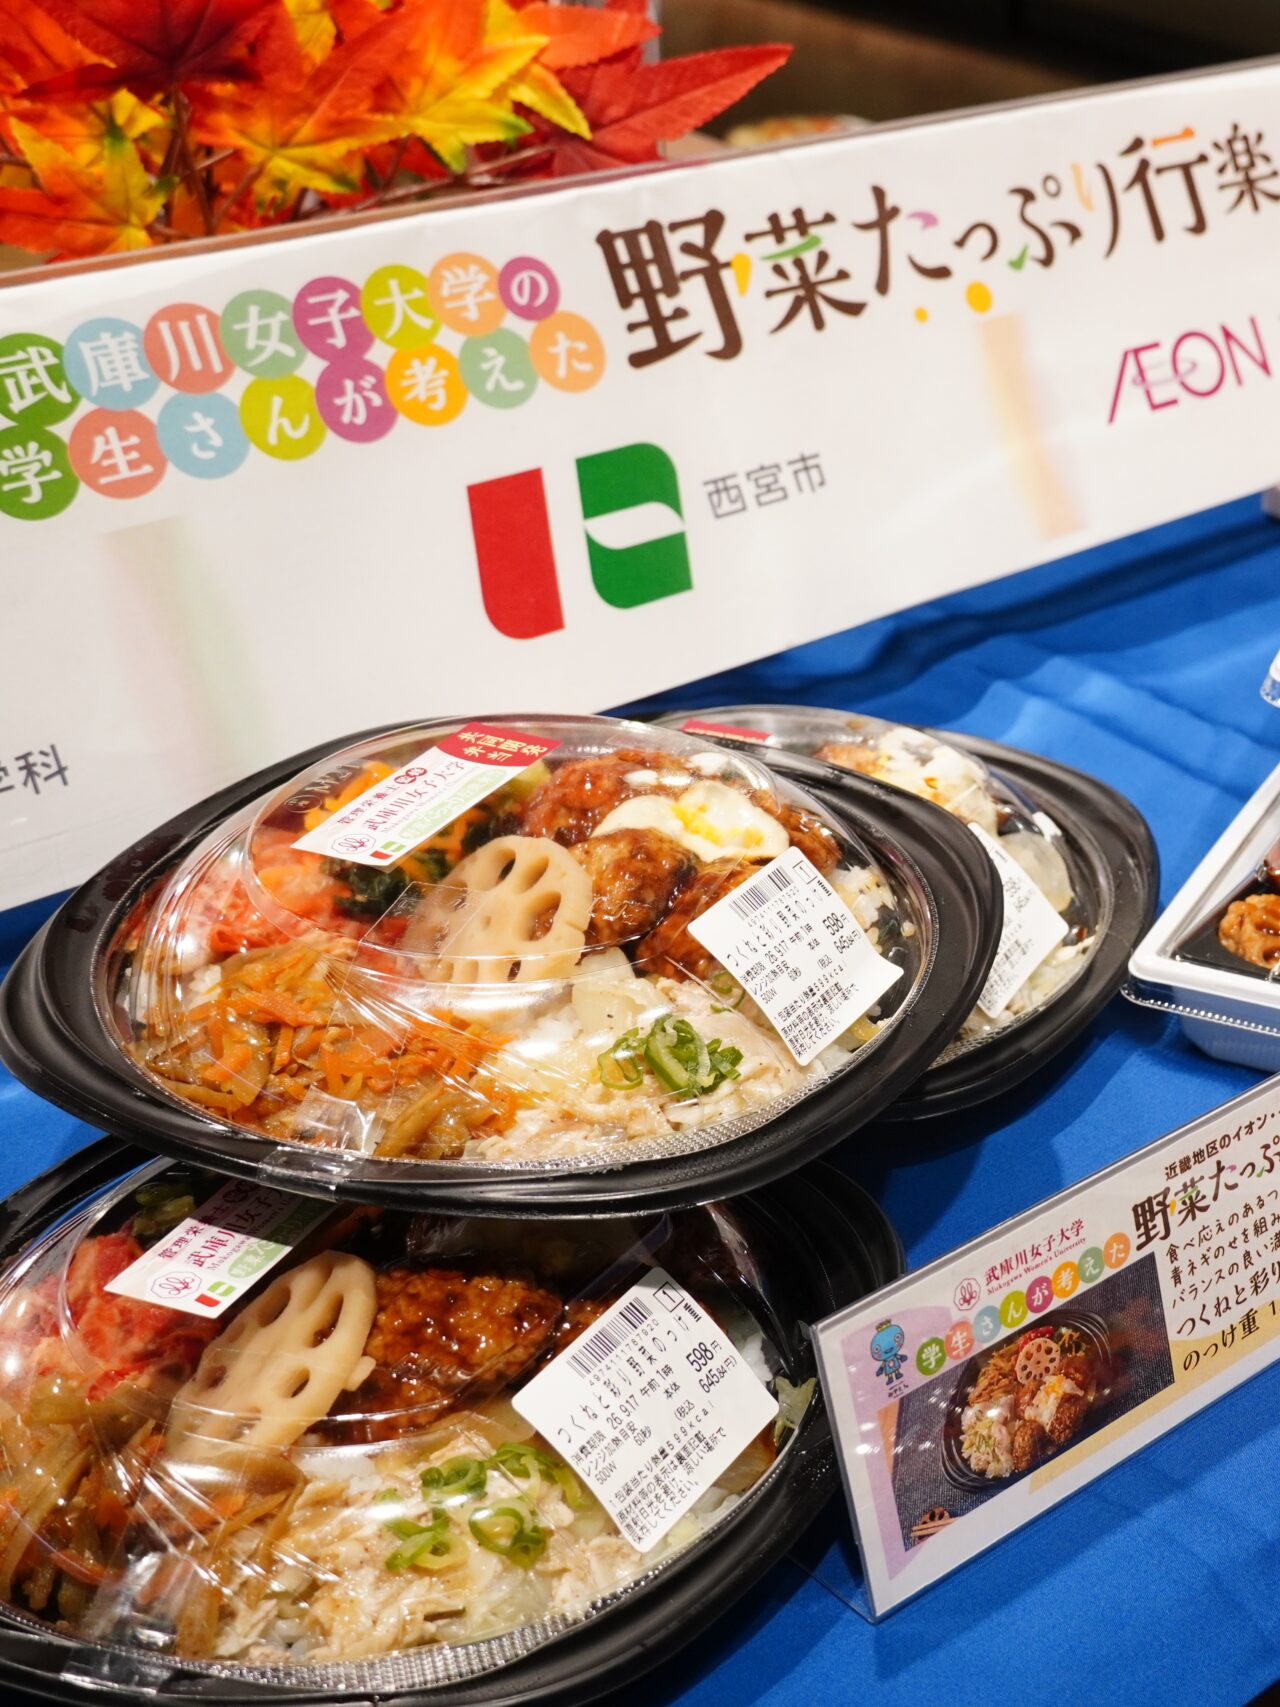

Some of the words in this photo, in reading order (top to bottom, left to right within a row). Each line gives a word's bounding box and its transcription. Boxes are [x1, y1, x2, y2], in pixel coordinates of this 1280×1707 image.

[0, 266, 548, 415] 武庫川女子大学の
[0, 331, 594, 504] 学生さんが考えた
[703, 452, 827, 521] 西宮市
[458, 732, 548, 756] 共同開発
[463, 746, 512, 762] 弁当
[363, 761, 464, 831] 武庫川女子大学
[986, 1218, 1084, 1286] 武庫川女子大学
[1023, 1256, 1052, 1274] Women's
[1054, 1237, 1086, 1258] University
[921, 1241, 1125, 1369] 学生さんが考えた
[1183, 1308, 1260, 1371] のっけ重
[574, 1431, 606, 1462] 消費期限
[640, 1378, 660, 1396] 午前
[664, 1382, 680, 1399] 本体
[582, 1420, 638, 1477] レンジ加熱目安
[594, 1460, 617, 1485] 500W
[616, 1430, 706, 1524] 原材料等の表示は裏面記載
